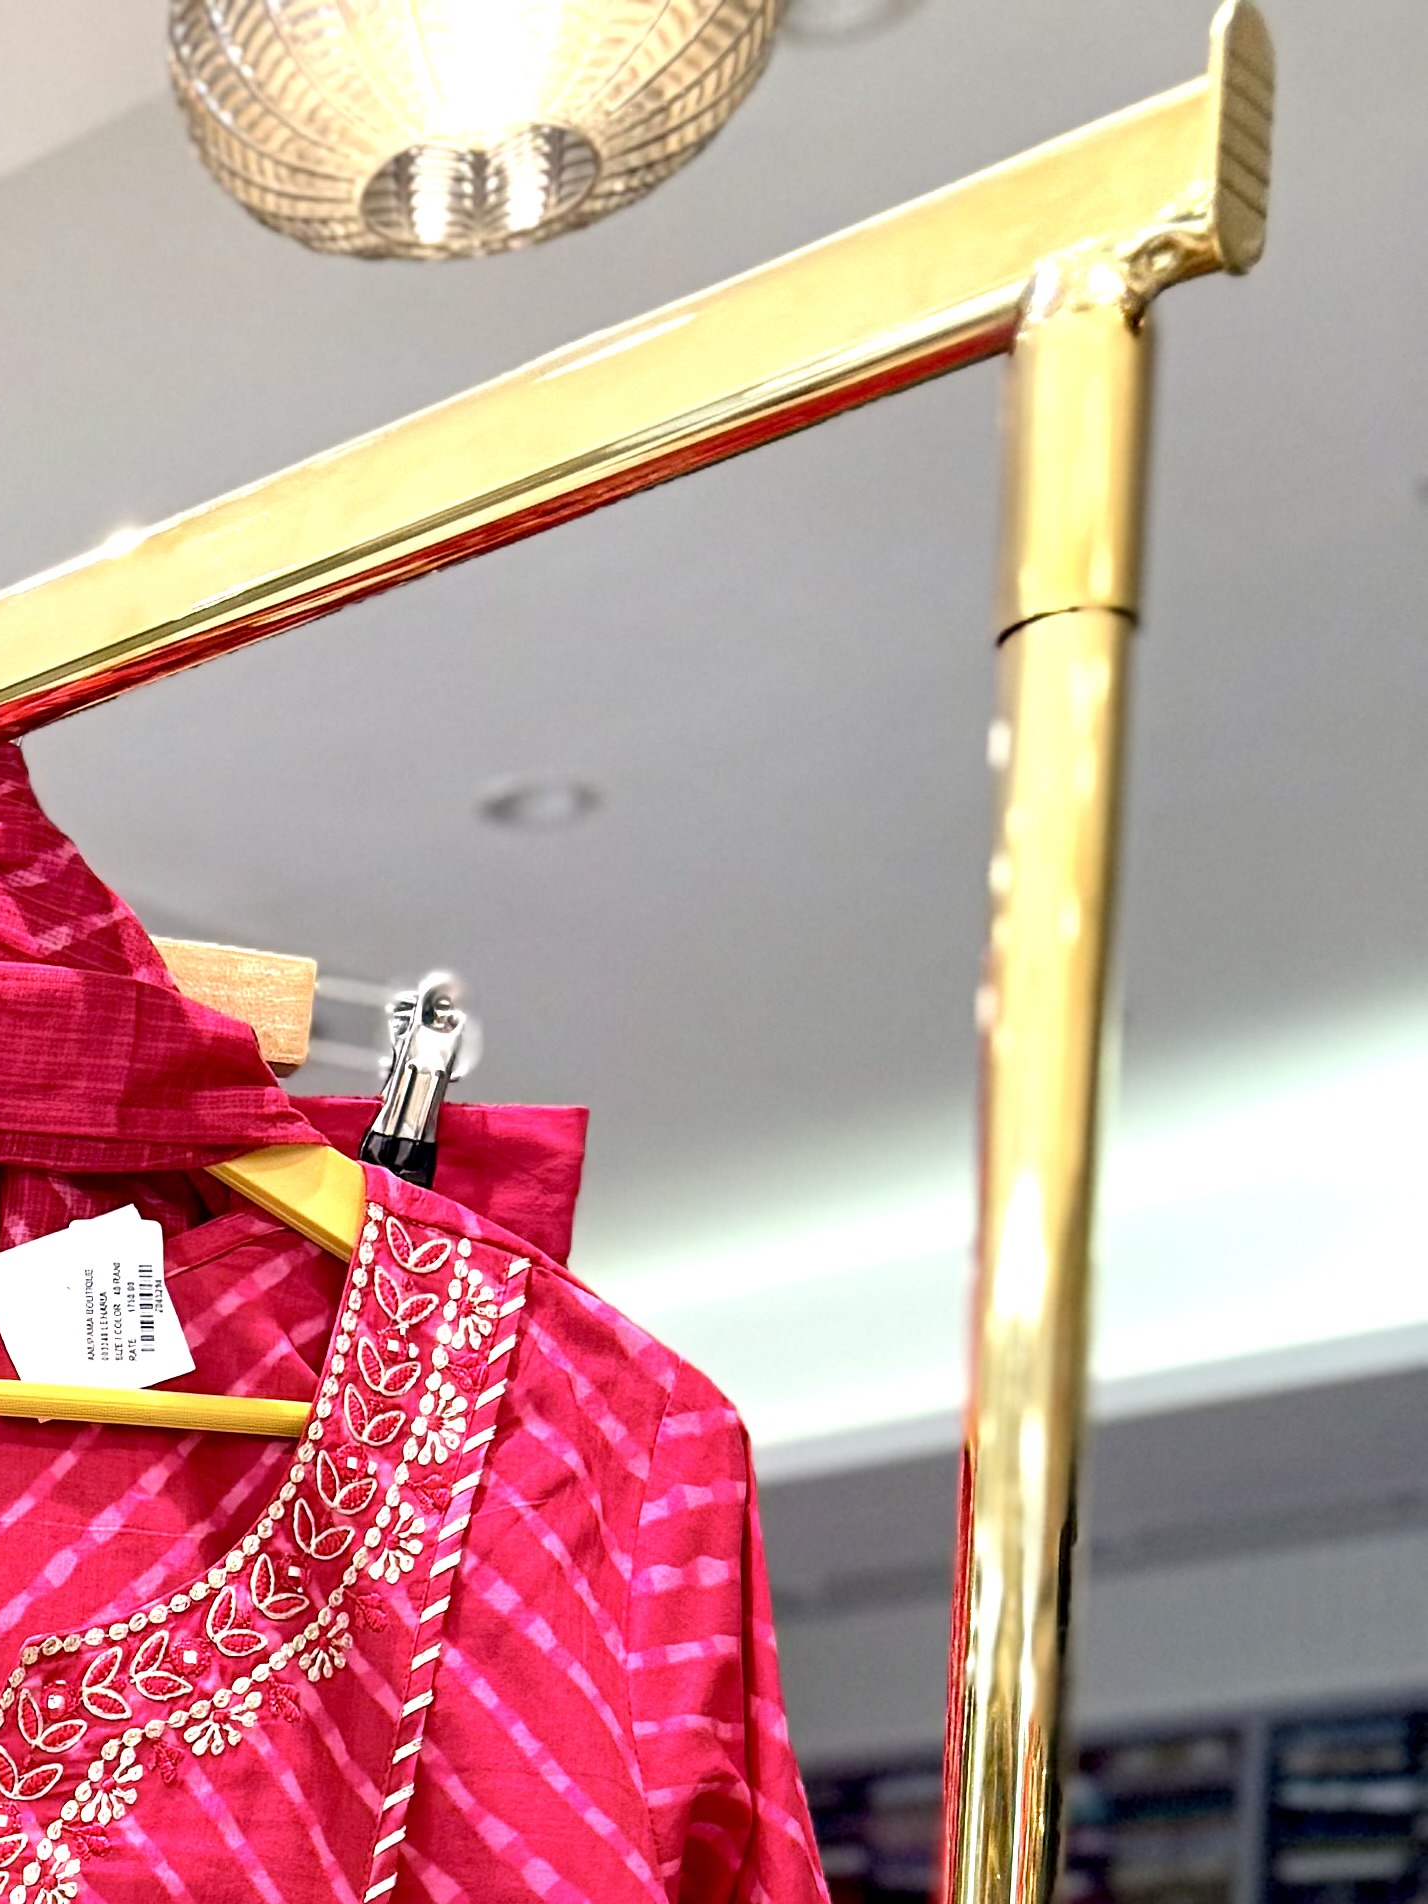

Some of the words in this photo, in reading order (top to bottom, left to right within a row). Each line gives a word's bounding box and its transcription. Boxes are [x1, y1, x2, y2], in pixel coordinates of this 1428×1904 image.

[85, 1269, 94, 1315] BOUTIQUE
[113, 1304, 122, 1335] COLOR
[128, 1339, 137, 1361] RATE
